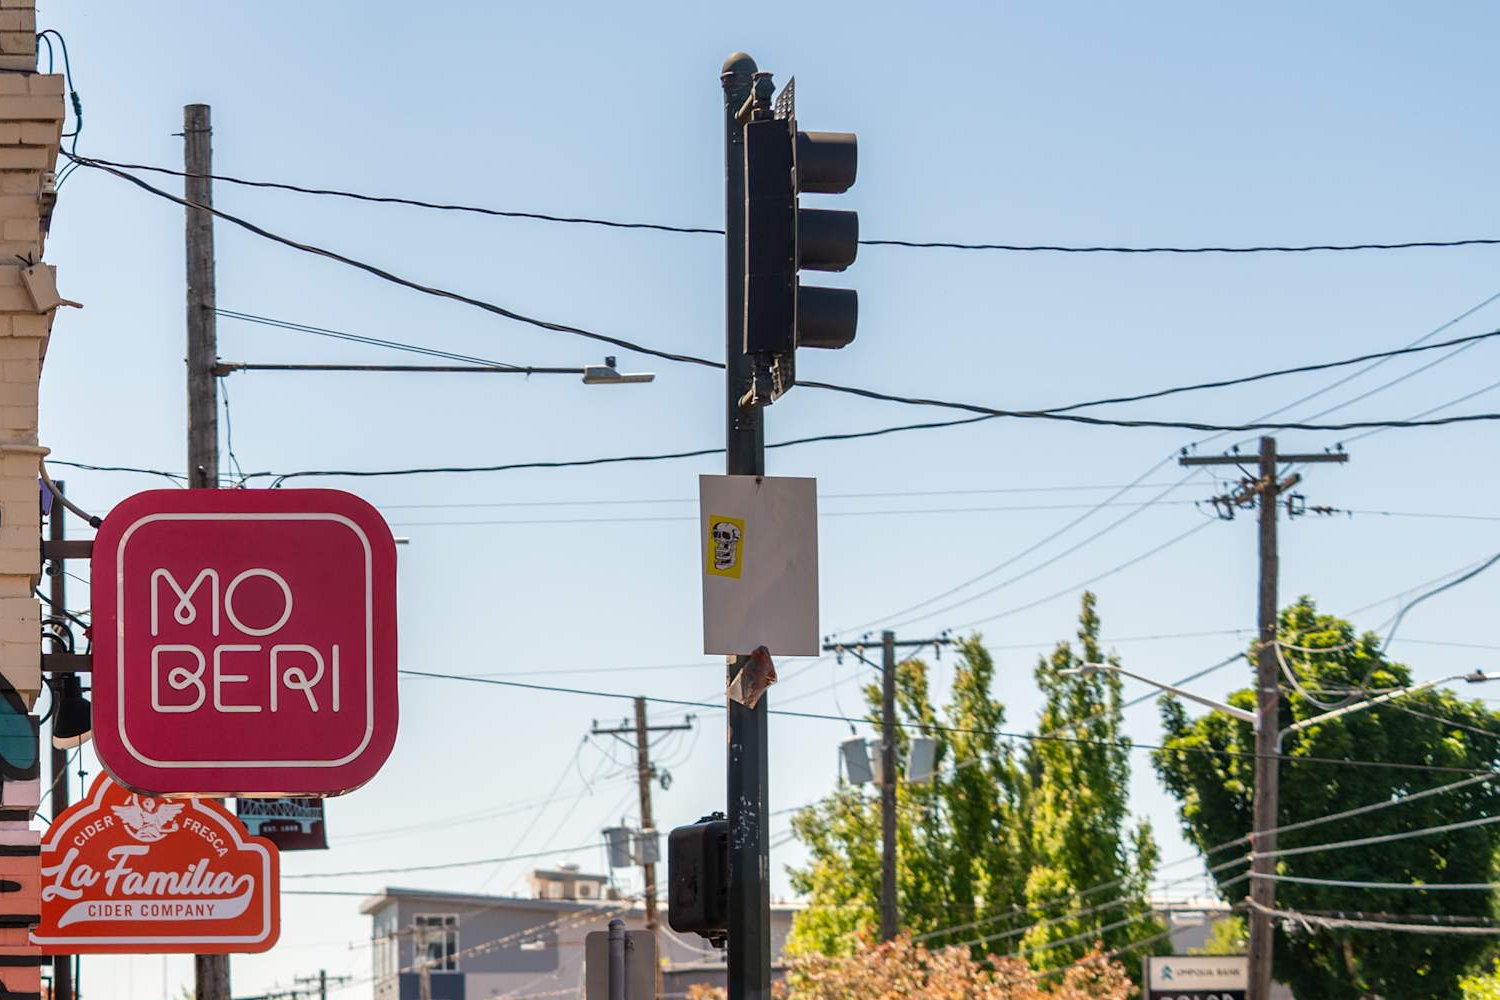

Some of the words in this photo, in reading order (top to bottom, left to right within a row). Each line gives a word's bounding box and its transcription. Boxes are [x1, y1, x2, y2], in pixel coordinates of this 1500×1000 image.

[151, 568, 293, 637] MO
[151, 644, 340, 713] BERI
[73, 815, 115, 847] CIDER
[182, 817, 229, 857] FRESCA
[41, 847, 100, 901] La
[104, 845, 253, 897] Familia
[88, 903, 133, 918] CIDER
[140, 903, 216, 918] COMPANY
